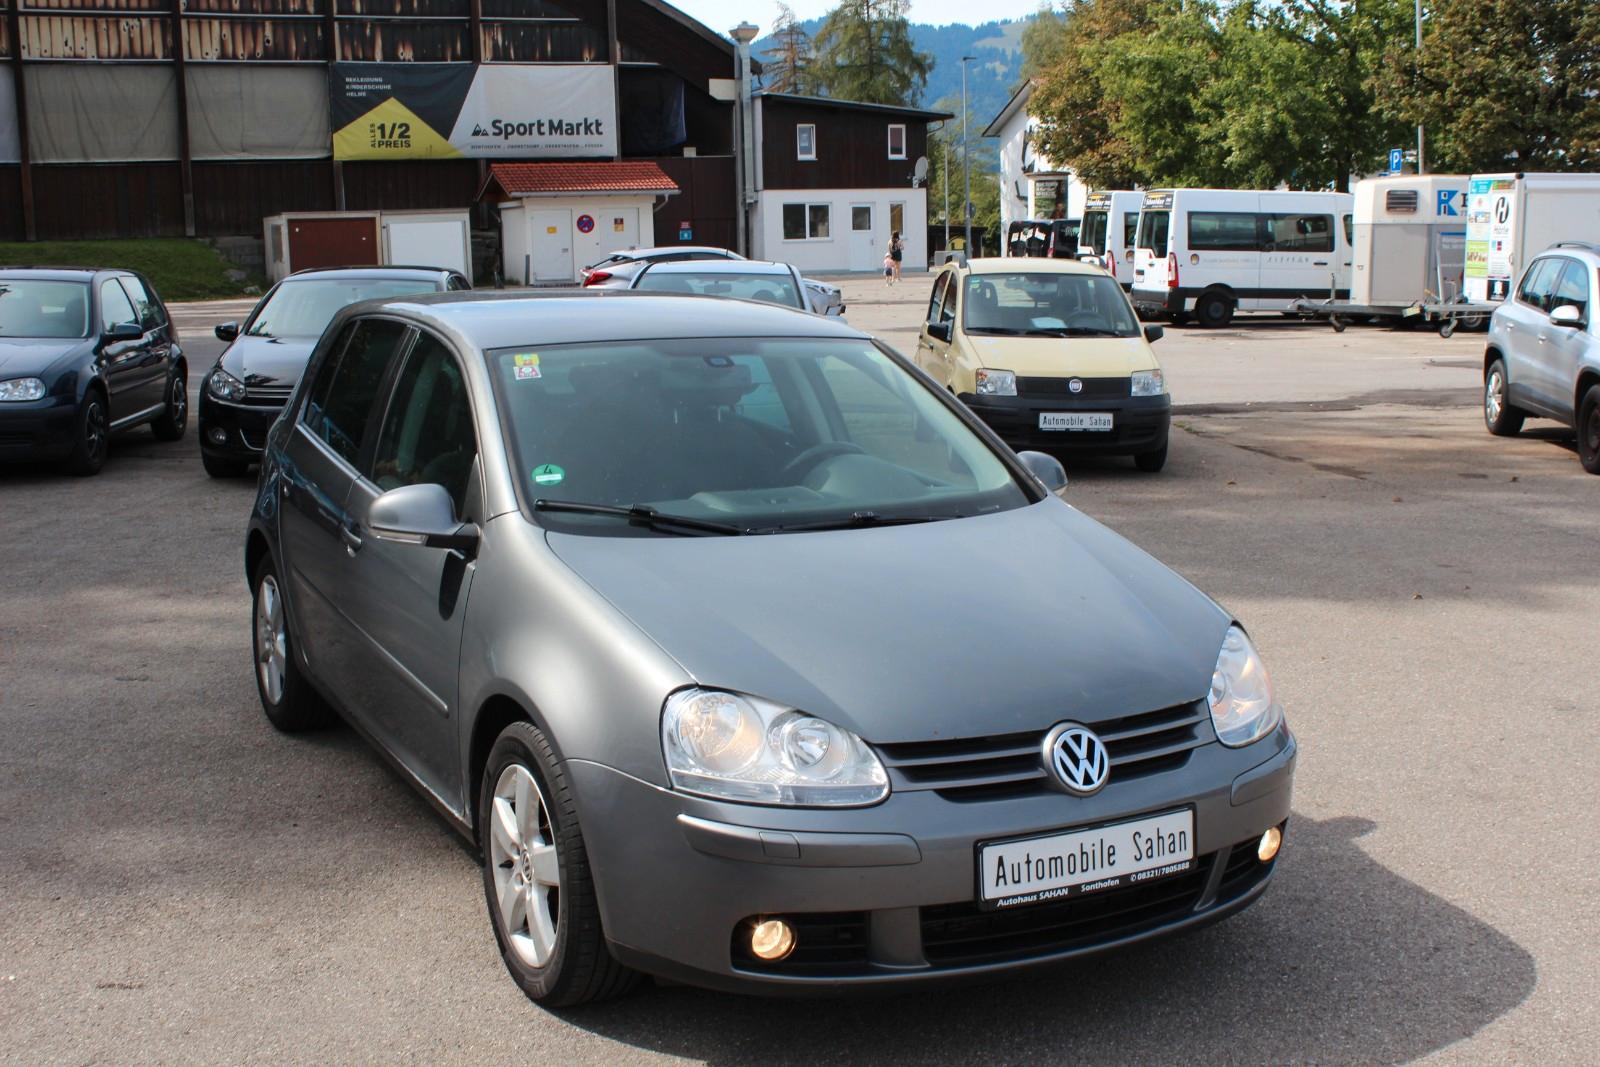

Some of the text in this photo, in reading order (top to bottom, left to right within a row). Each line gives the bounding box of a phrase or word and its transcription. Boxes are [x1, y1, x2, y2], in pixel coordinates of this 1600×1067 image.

[377, 123, 411, 139] 1/2
[491, 117, 604, 140] Sport Markt
[377, 140, 411, 148] PREIS
[1392, 153, 1400, 169] P
[1042, 416, 1111, 426] Automobile Sahan
[995, 827, 1187, 887] Automobile Sahan
[997, 894, 1038, 908] Autohaus
[1039, 887, 1069, 901] SAHAN
[1080, 878, 1120, 893] Sonthofen
